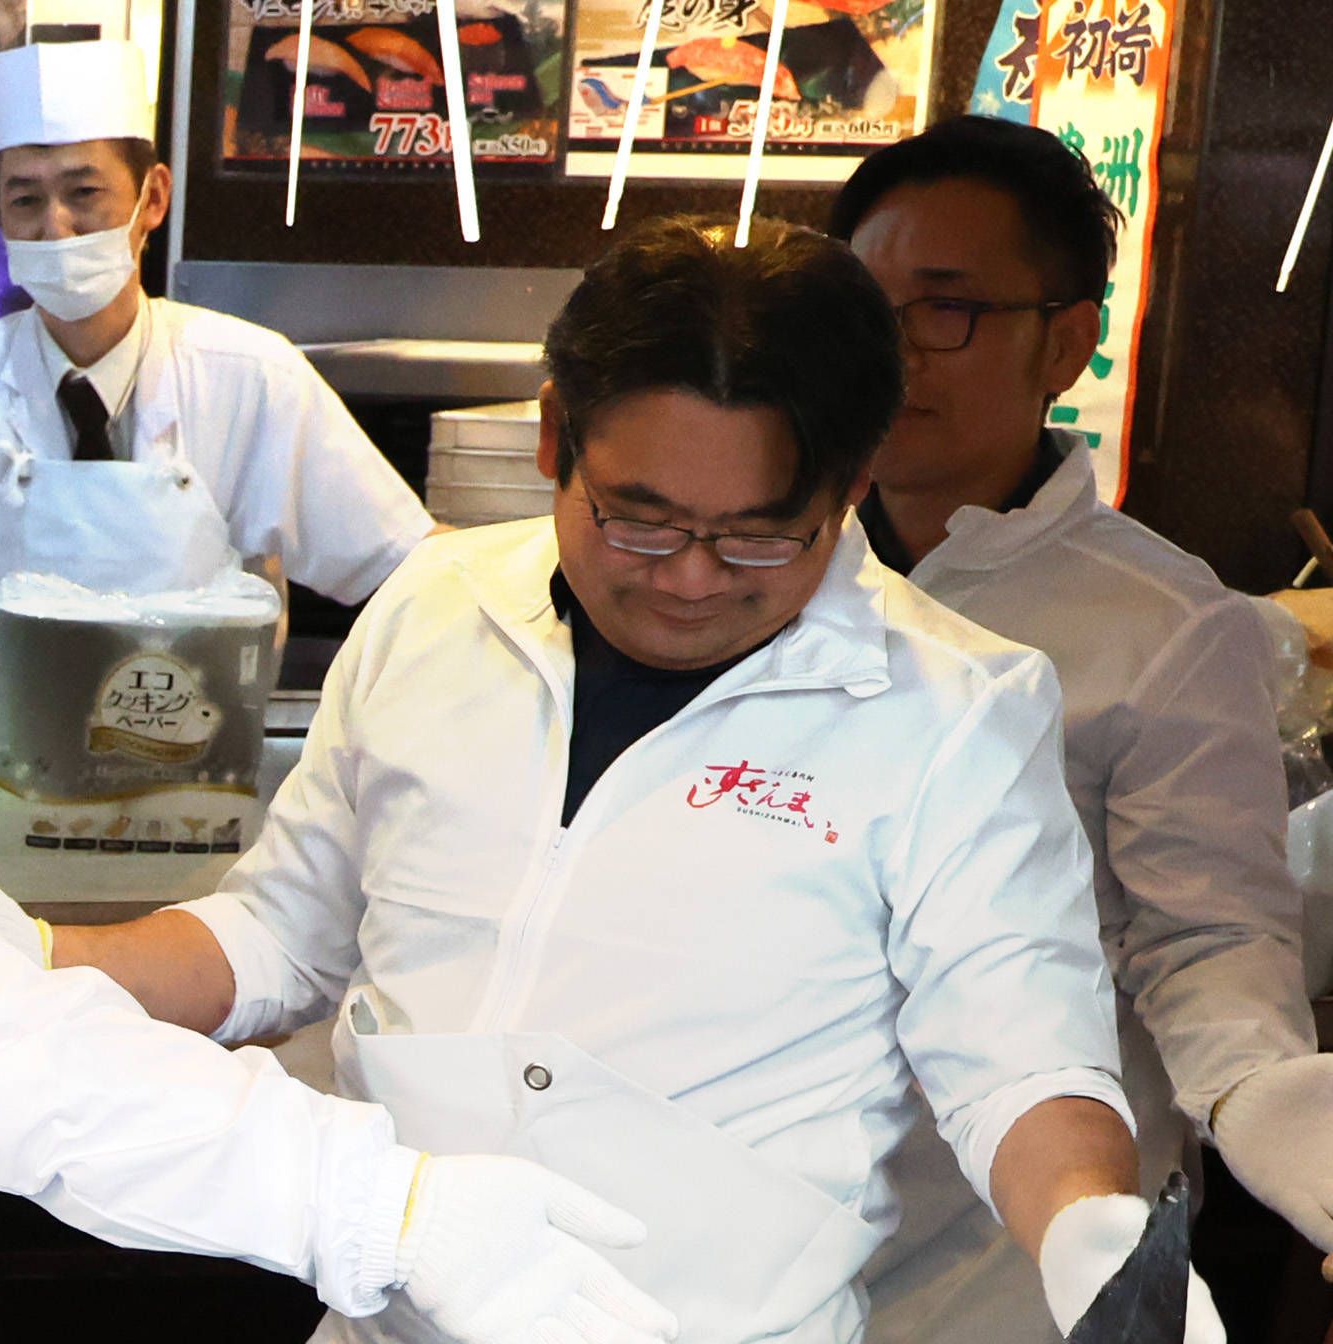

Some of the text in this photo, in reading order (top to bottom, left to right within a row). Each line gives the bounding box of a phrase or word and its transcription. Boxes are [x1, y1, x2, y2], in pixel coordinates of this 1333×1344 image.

[1053, 1, 1152, 87] 初荷
[370, 112, 452, 155] 773
[128, 671, 174, 691] エコ
[107, 688, 195, 714] クッキング
